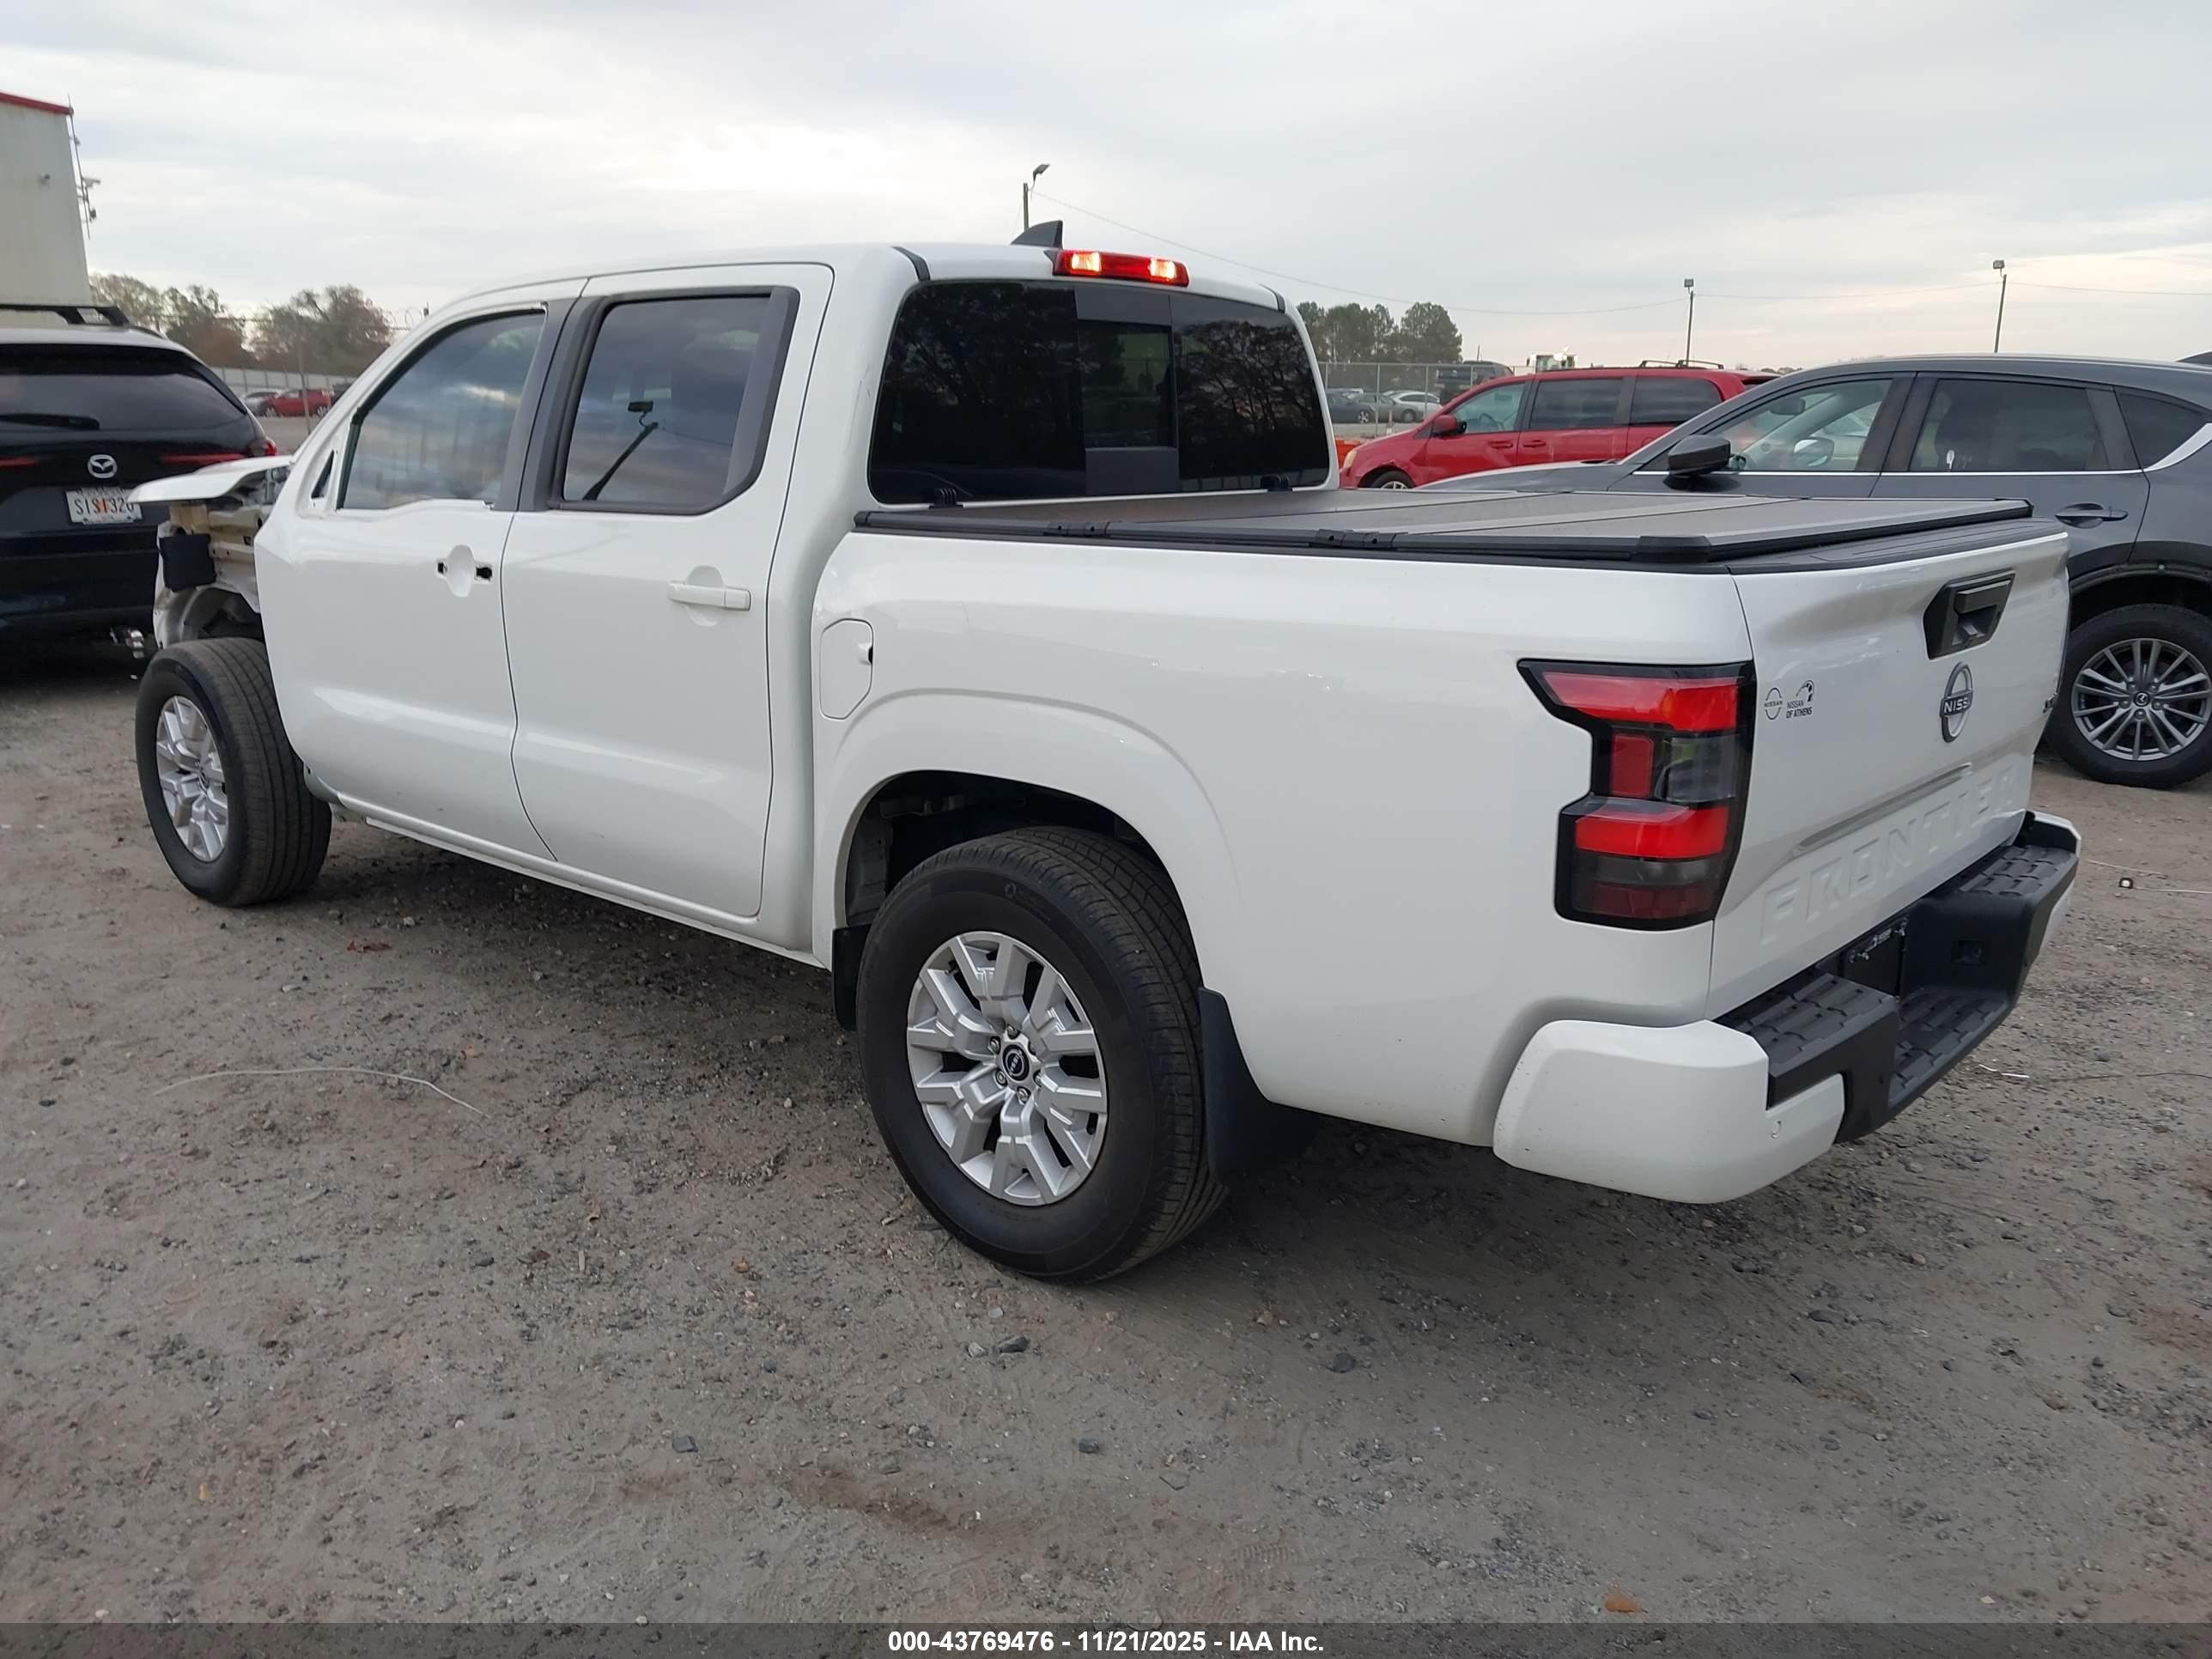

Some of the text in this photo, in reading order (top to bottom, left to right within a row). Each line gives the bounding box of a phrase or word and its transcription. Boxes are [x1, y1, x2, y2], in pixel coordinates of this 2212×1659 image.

[1786, 700, 1804, 709] NISSAN
[1943, 696, 1969, 714] NISS
[1786, 706, 1813, 719] OF ATHENS
[1760, 764, 2017, 946] FRONTIER
